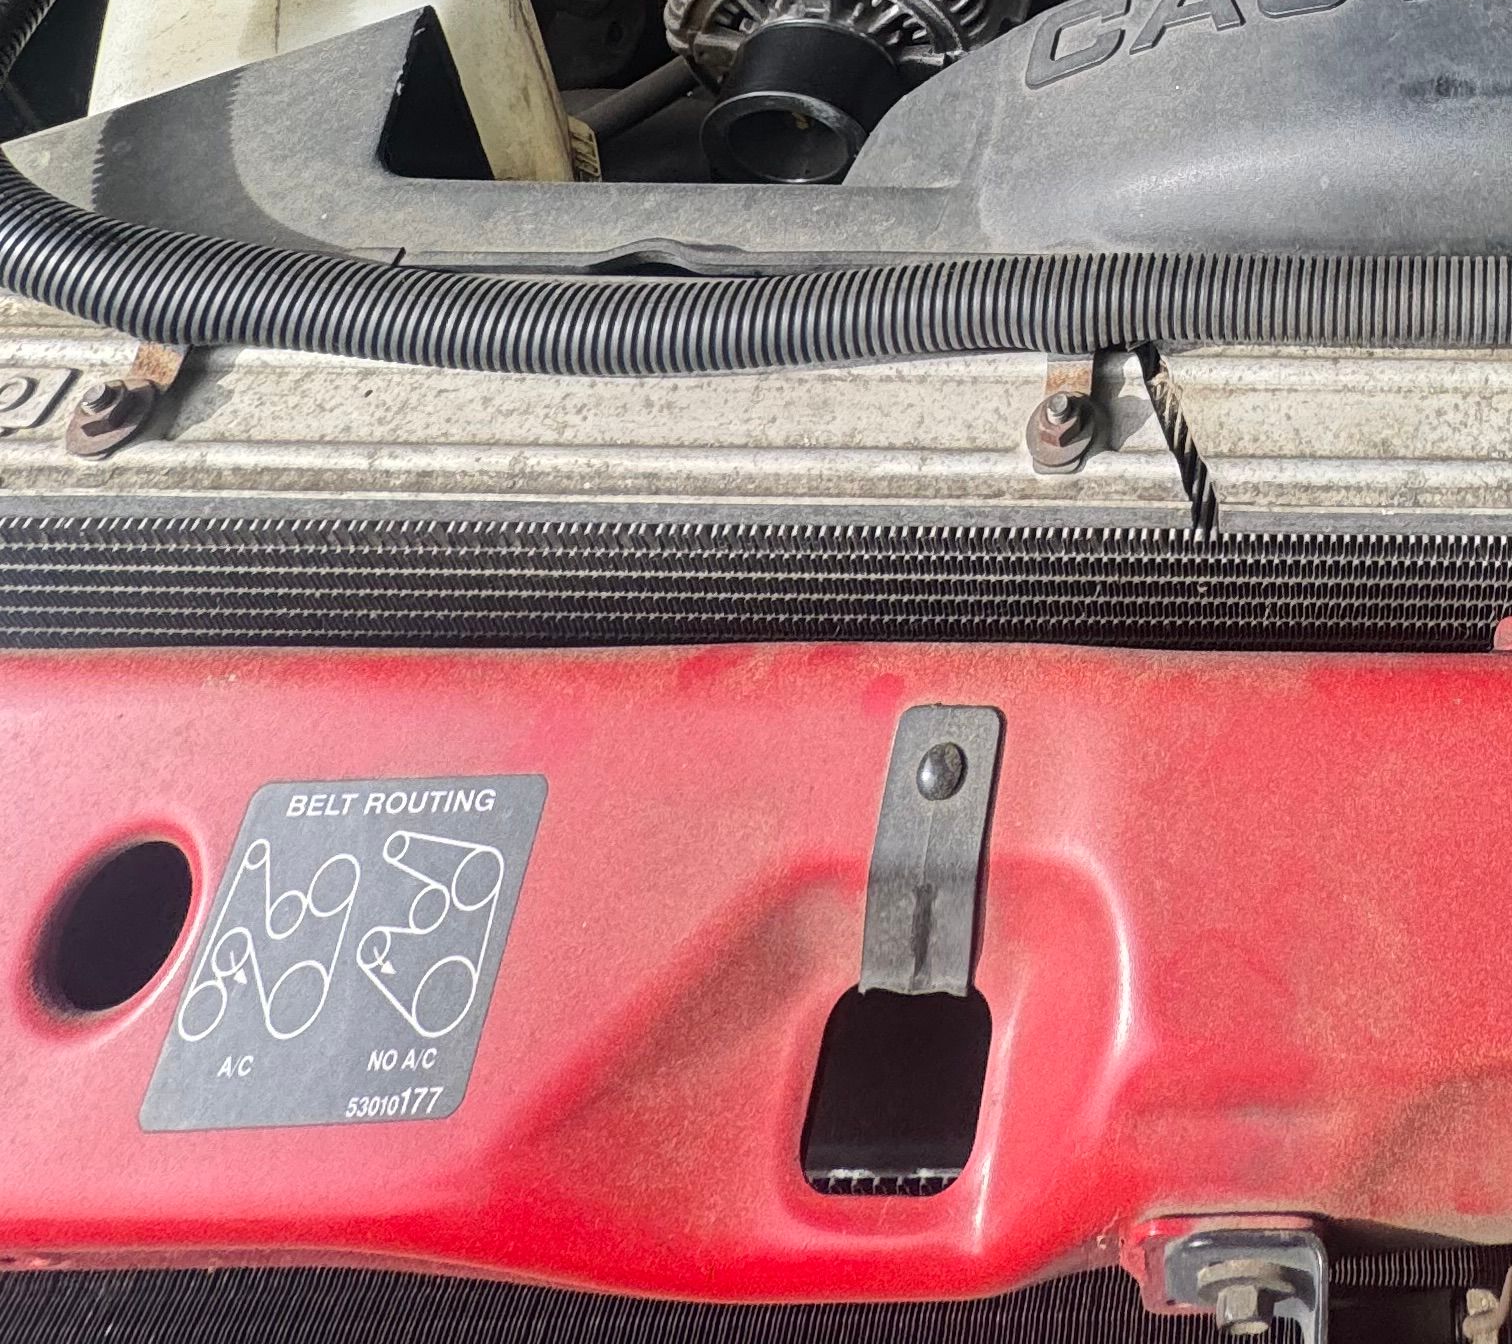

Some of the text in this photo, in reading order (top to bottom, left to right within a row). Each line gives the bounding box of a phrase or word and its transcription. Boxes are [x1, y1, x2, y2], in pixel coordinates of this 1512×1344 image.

[285, 788, 498, 818] BELT ROUTING
[217, 1054, 254, 1078] A/C
[366, 1047, 438, 1073] NO A/C
[345, 1086, 444, 1119] 53010177
